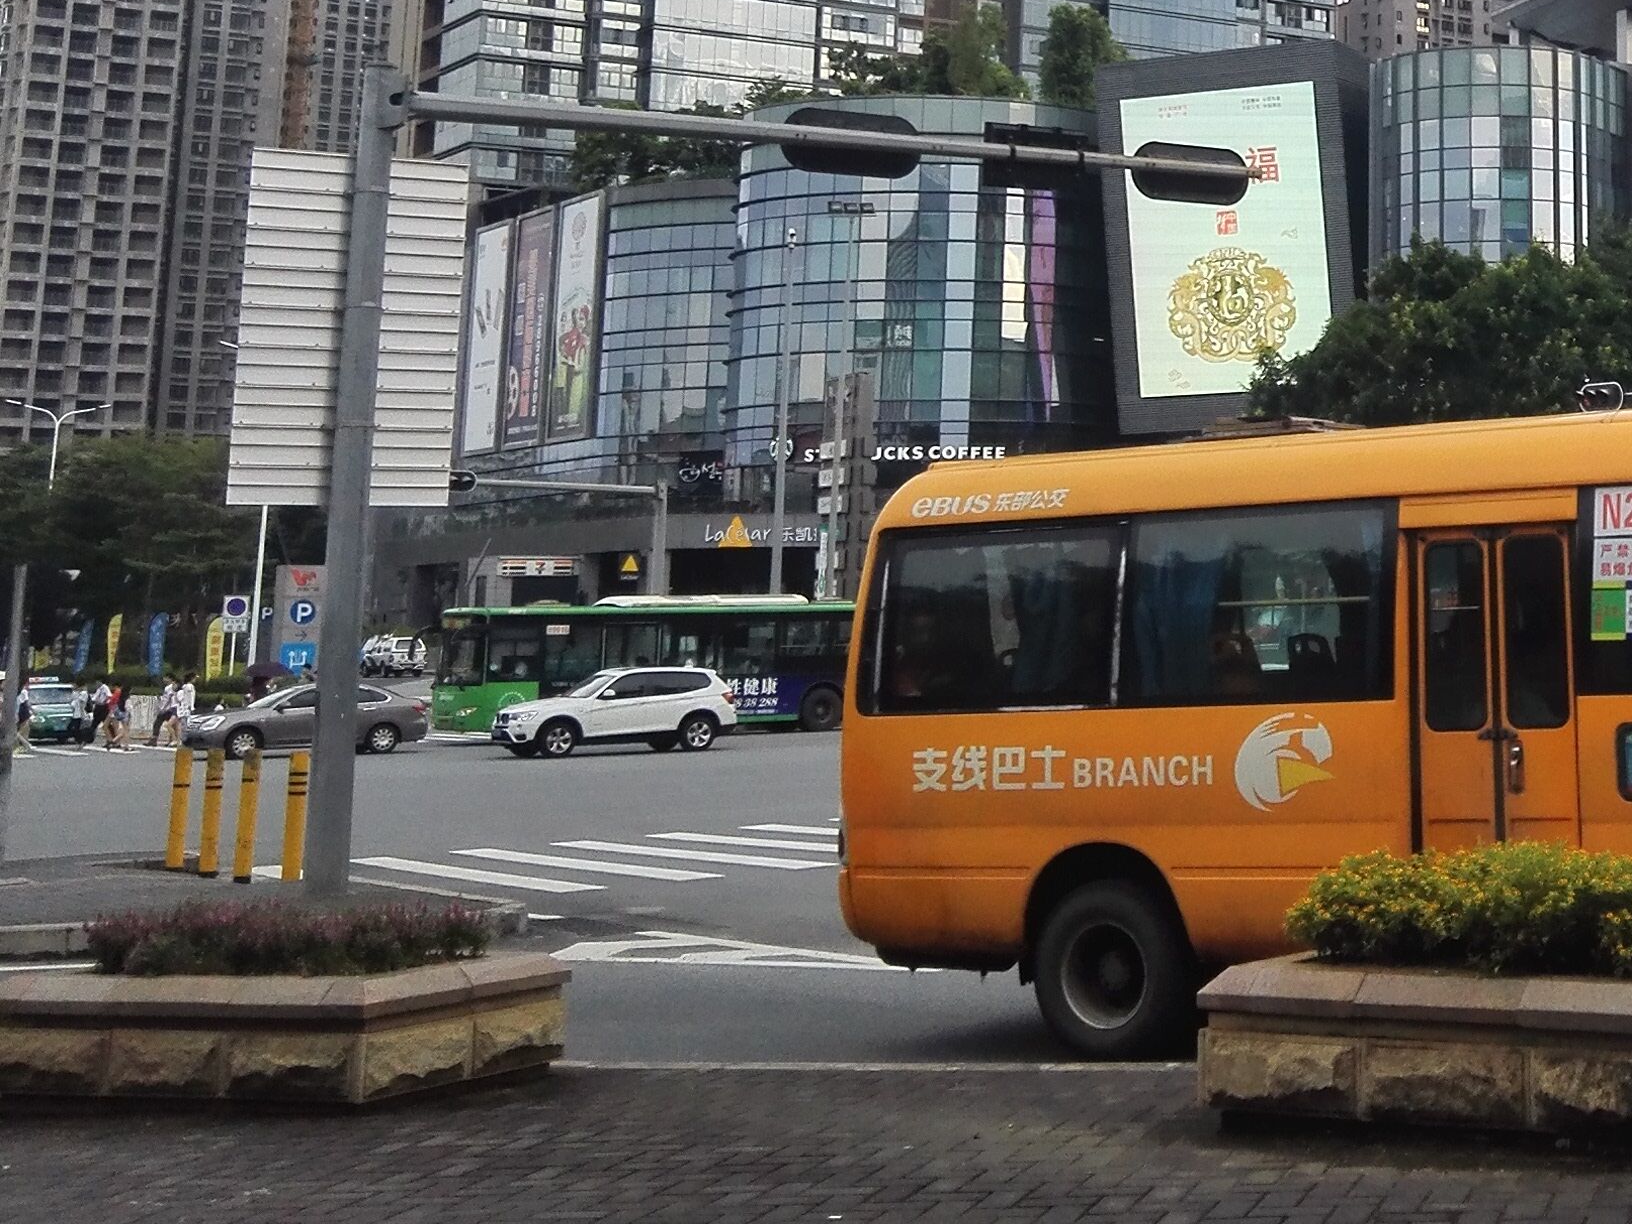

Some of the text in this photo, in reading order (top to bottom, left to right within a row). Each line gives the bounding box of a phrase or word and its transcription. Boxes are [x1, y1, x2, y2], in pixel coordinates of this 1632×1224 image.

[928, 445, 1006, 460] COFFEE
[911, 488, 1070, 518] eBUS 东部公交
[262, 607, 274, 620] P
[296, 603, 313, 623] P
[912, 744, 1214, 793] 支线巴士 BRANCH
